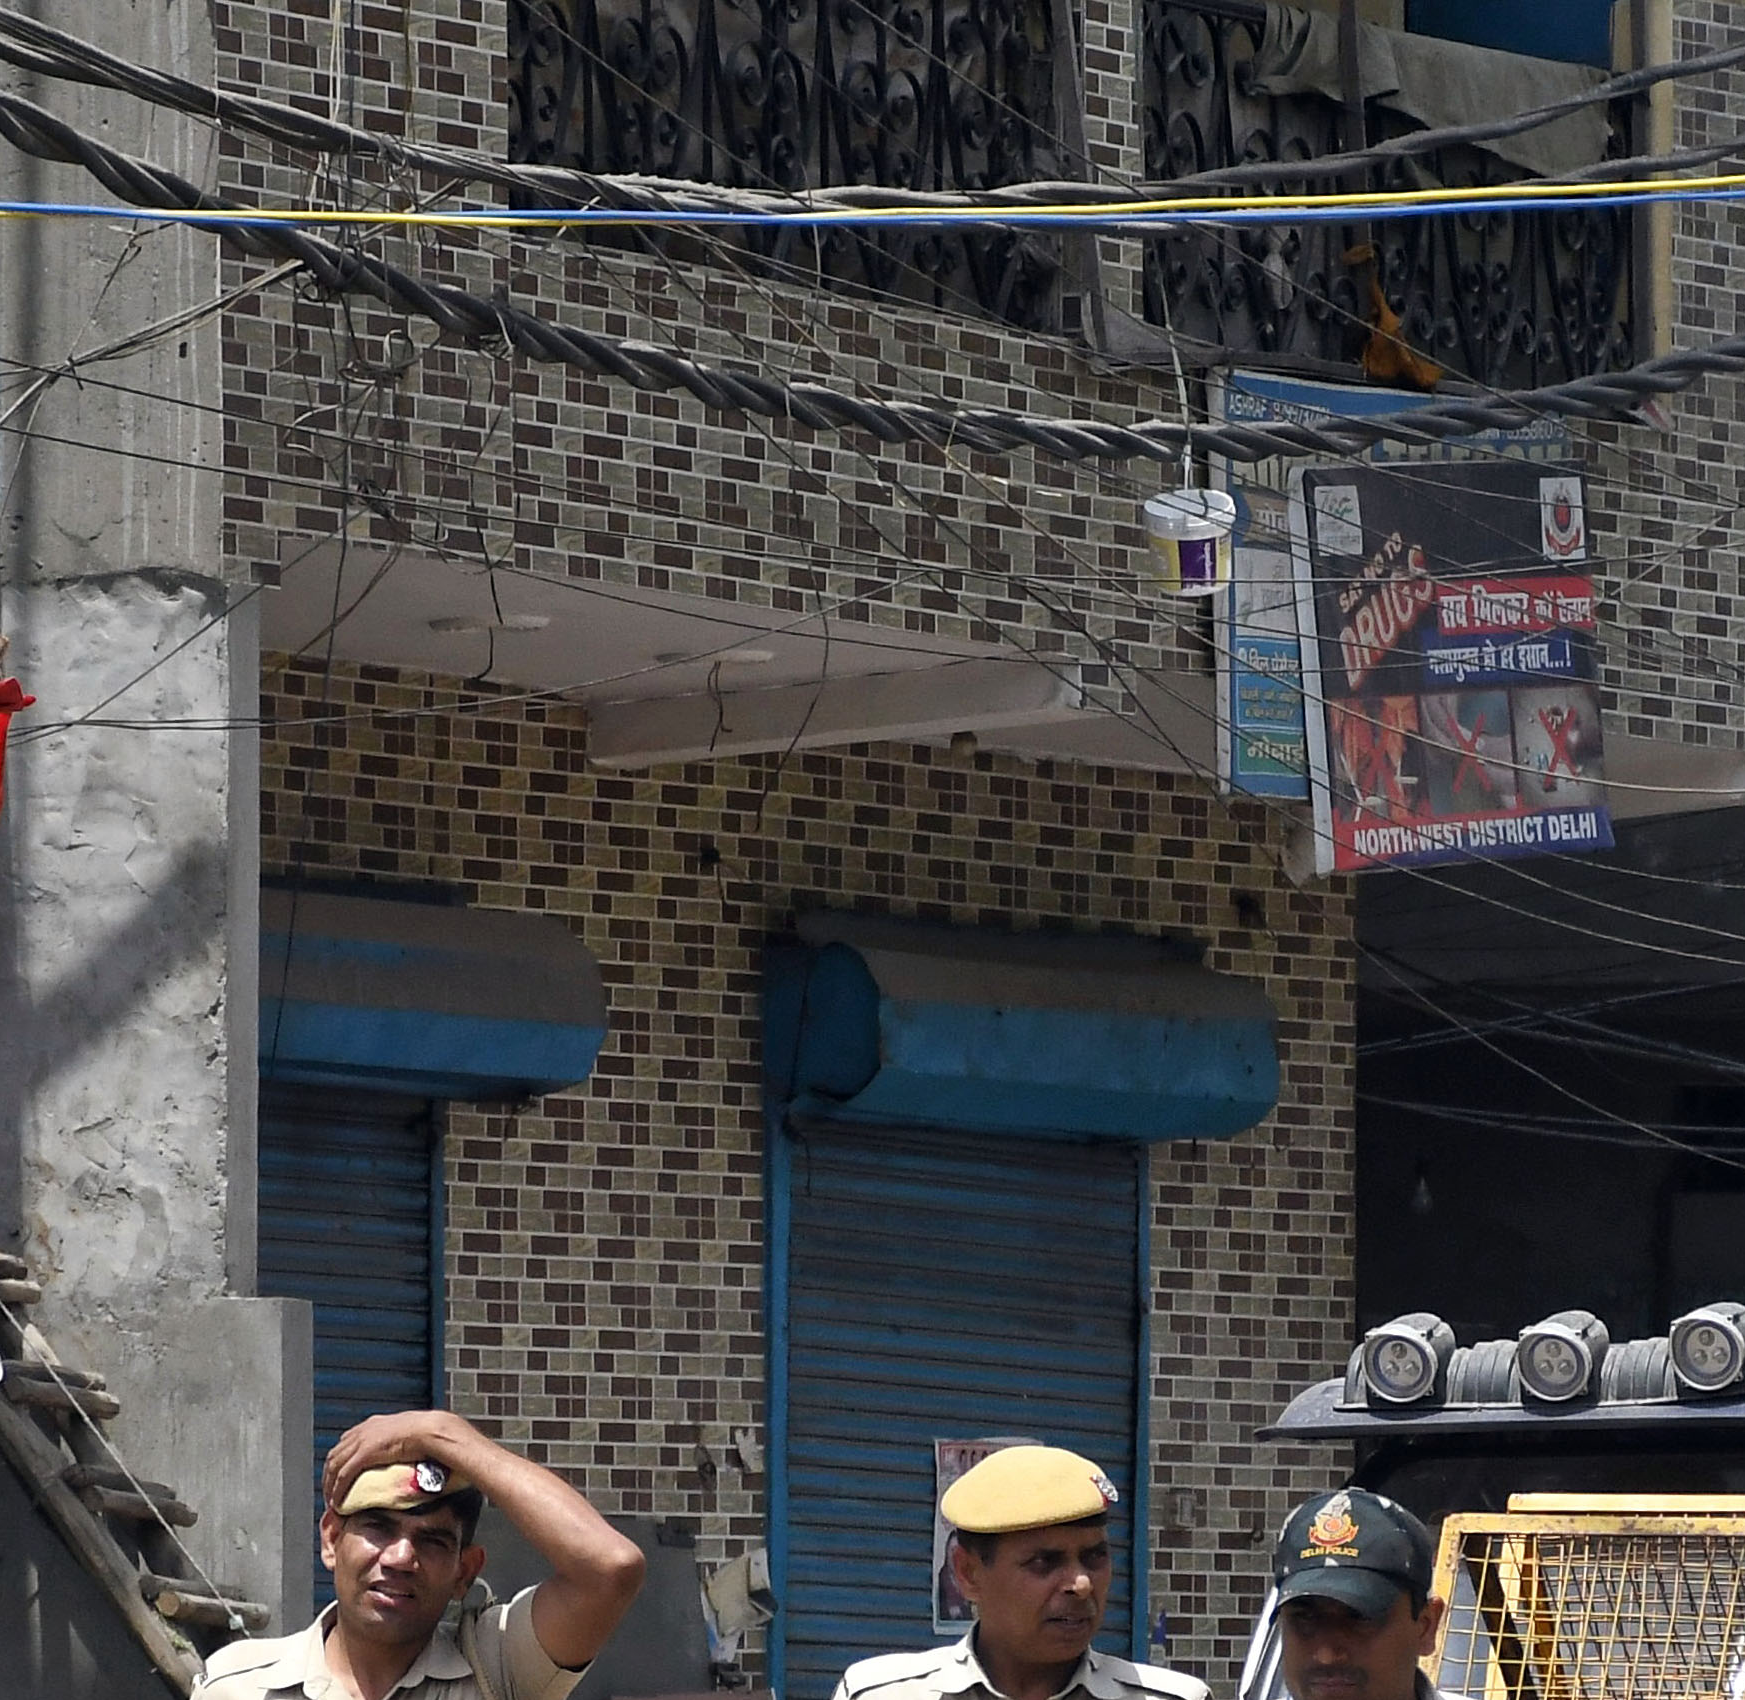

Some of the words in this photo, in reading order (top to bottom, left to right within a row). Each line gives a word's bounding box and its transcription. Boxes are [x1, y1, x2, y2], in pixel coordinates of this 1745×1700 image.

[1339, 544, 1432, 690] DRUGS
[1246, 736, 1304, 762] मोबाई
[1469, 815, 1543, 847] DISTRICT
[1547, 812, 1599, 841] DELHI
